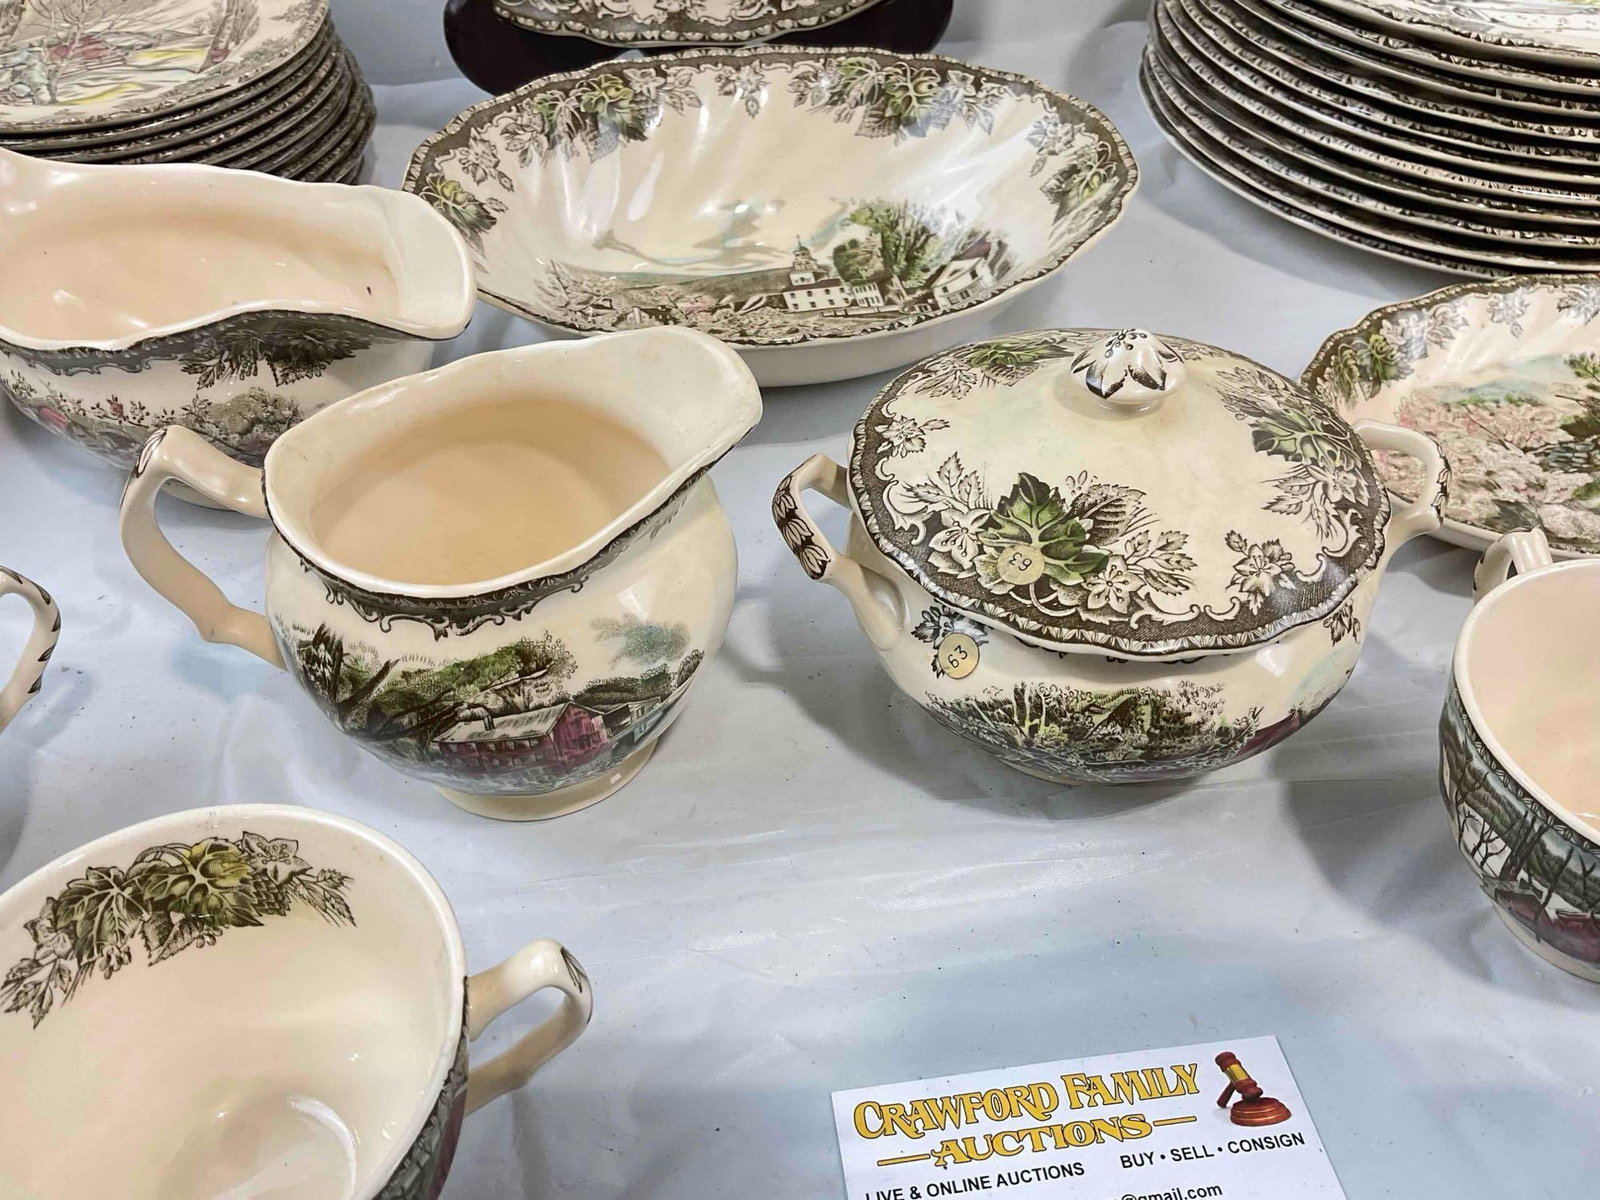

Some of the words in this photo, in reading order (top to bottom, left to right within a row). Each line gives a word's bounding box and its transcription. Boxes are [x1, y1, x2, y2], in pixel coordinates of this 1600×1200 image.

[947, 644, 969, 669] 63
[853, 1082, 1060, 1140] CRAWFORD
[1061, 1063, 1201, 1110] FAMILY
[931, 1113, 1153, 1167] AUCTIONS
[1119, 1151, 1155, 1169] BUY
[1170, 1144, 1215, 1162] SELL
[1227, 1132, 1306, 1155] CONSIGN
[909, 1185, 923, 1200] &
[926, 1175, 993, 1197] ONLINE
[996, 1161, 1086, 1187] AUCTIONS
